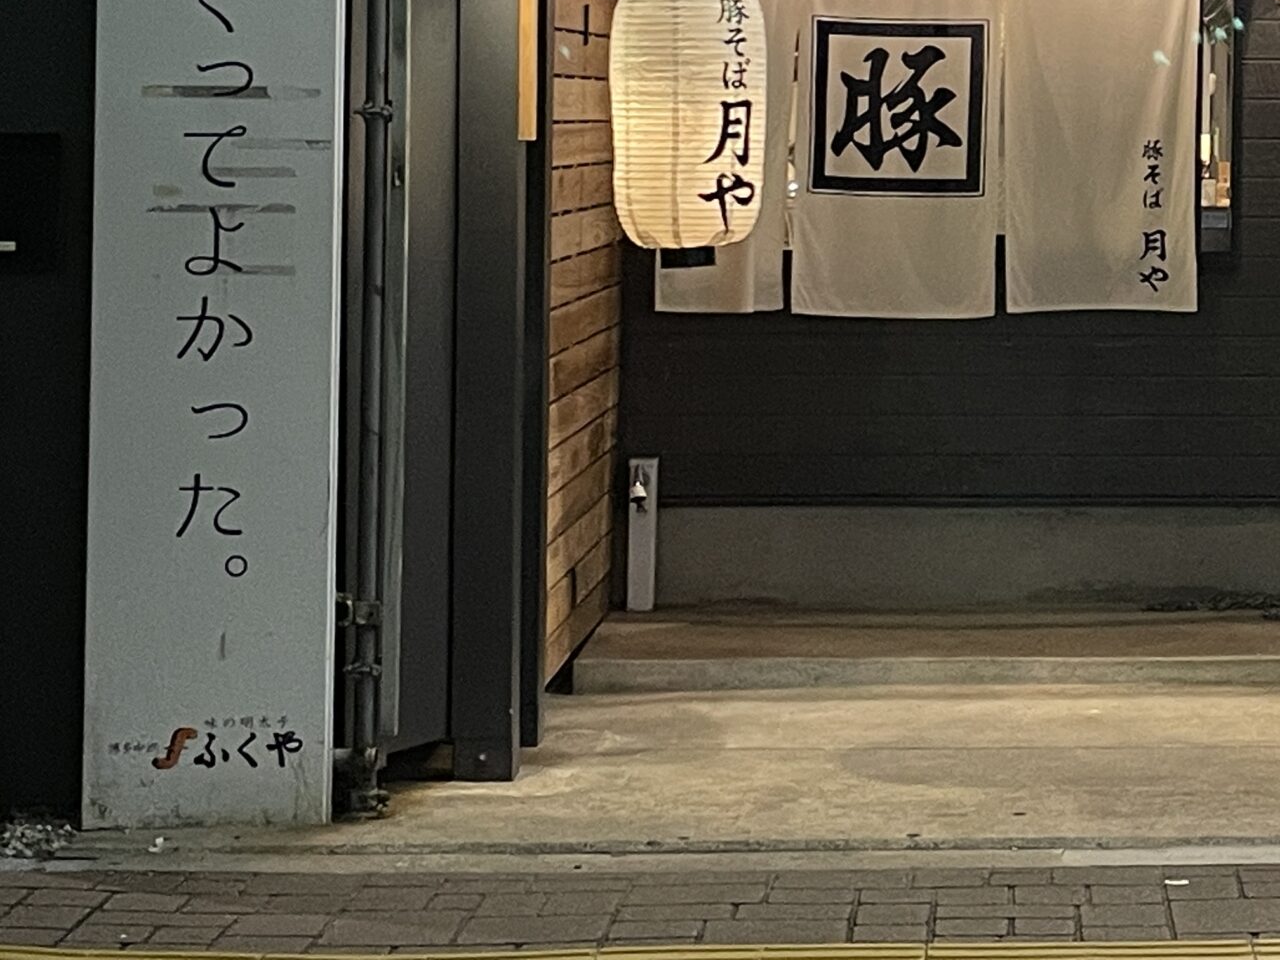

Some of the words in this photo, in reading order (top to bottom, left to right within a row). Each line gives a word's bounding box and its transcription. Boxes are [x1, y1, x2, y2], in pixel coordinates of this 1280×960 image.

[830, 45, 963, 173] 豚
[193, 731, 303, 769] ふくや
